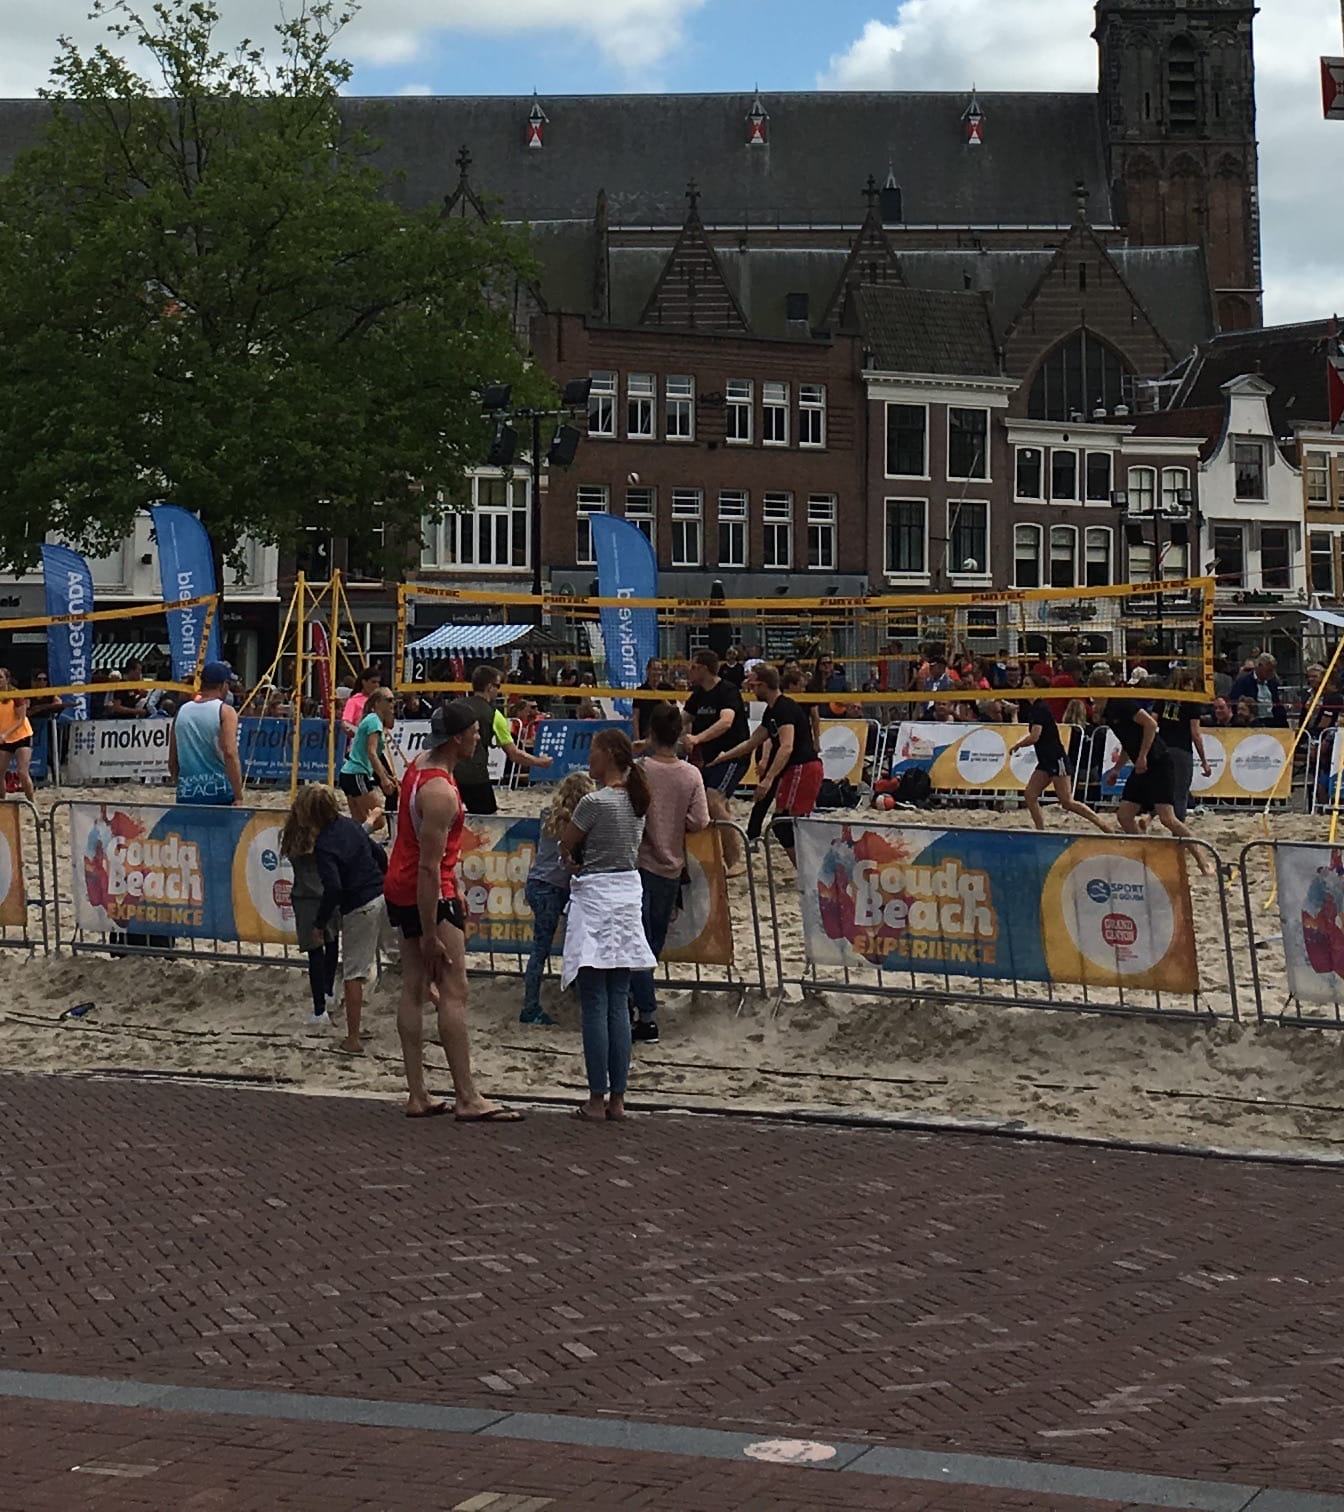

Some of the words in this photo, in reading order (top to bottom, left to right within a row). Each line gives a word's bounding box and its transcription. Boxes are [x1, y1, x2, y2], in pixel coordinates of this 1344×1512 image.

[108, 835, 198, 869] Gouda
[108, 866, 203, 901] Beach
[856, 858, 987, 902] Gouda
[108, 902, 203, 926] EXPERIENCE
[854, 889, 995, 936] Beach
[853, 934, 997, 964] EXPERIENCE
